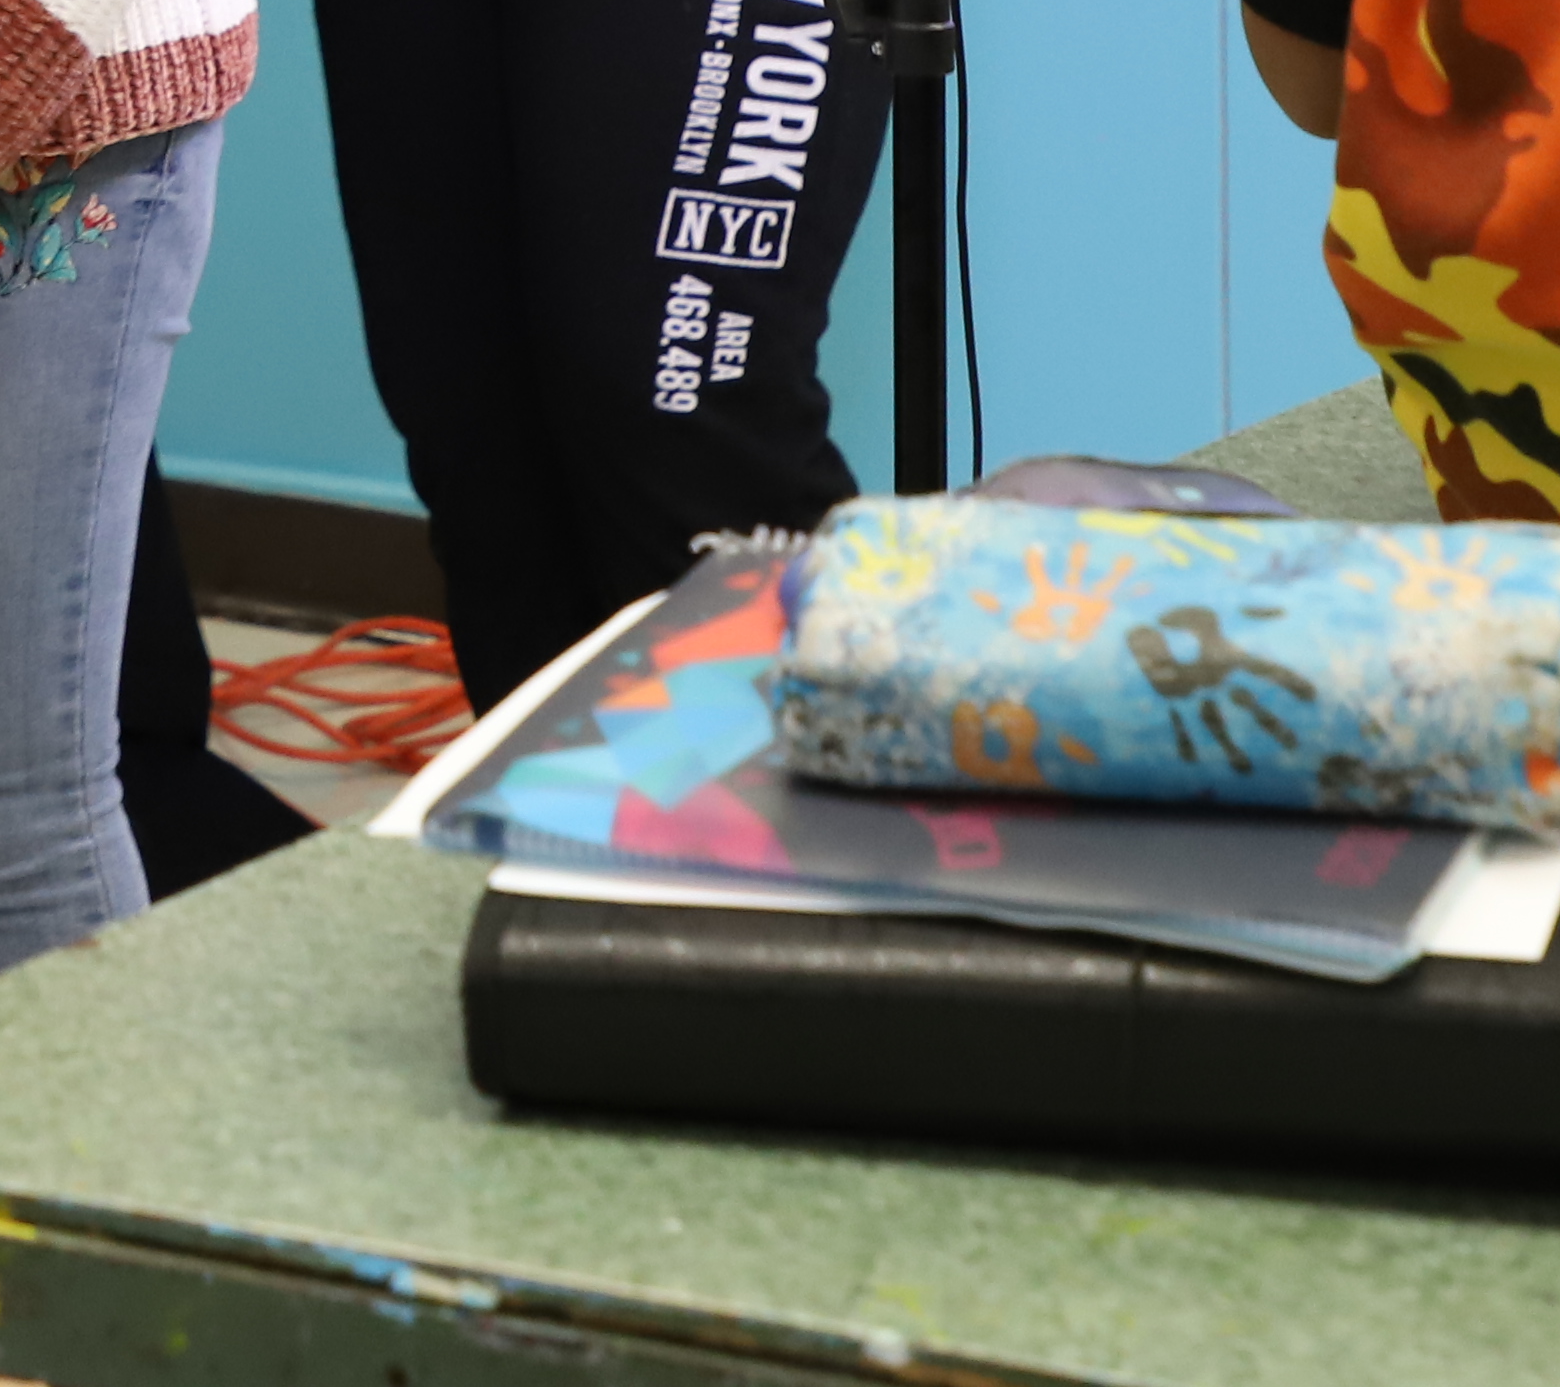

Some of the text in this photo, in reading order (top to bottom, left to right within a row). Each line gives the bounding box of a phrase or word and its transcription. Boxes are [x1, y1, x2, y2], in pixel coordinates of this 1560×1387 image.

[718, 20, 834, 191] YORK
[678, 200, 780, 258] NYC
[653, 273, 713, 414] 468.489
[709, 311, 754, 384] AREA
